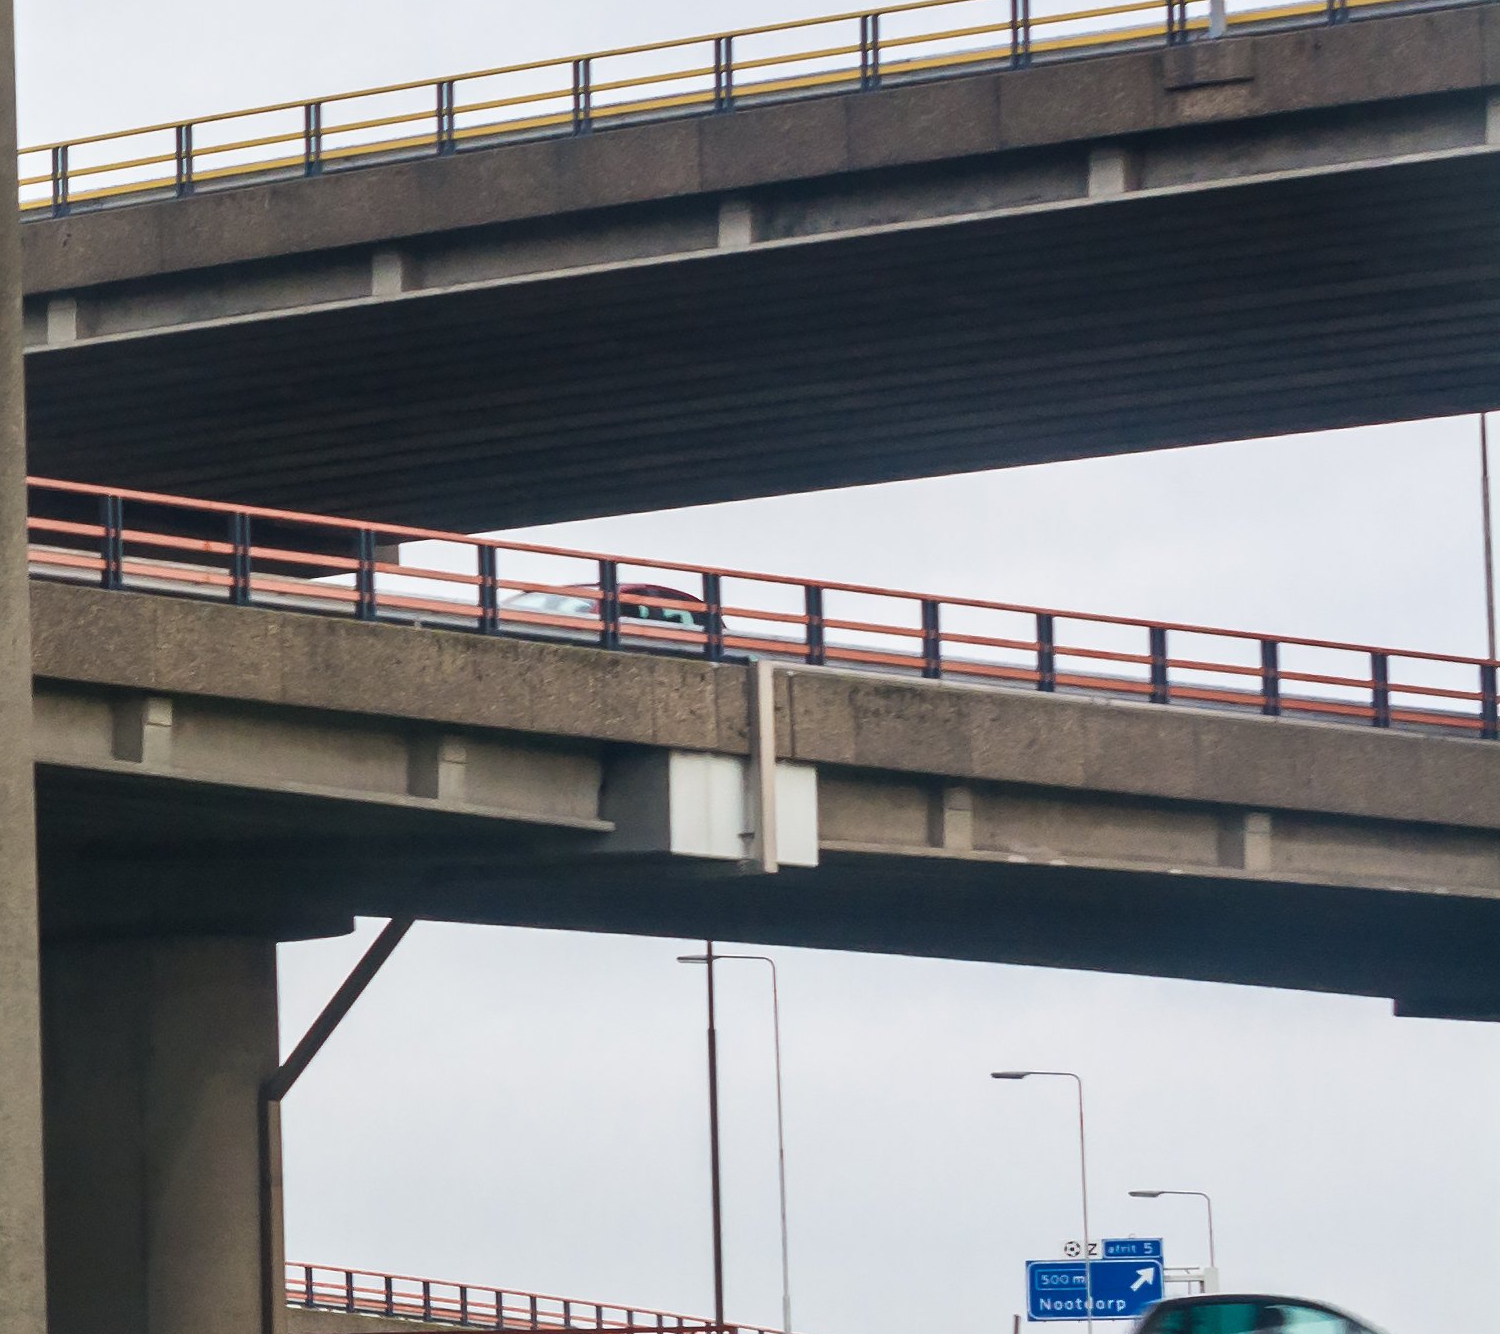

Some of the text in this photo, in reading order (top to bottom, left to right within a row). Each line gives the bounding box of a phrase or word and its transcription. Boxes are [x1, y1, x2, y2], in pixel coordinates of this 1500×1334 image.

[1107, 1242, 1154, 1255] afrit 5
[1040, 1274, 1069, 1286] 500
